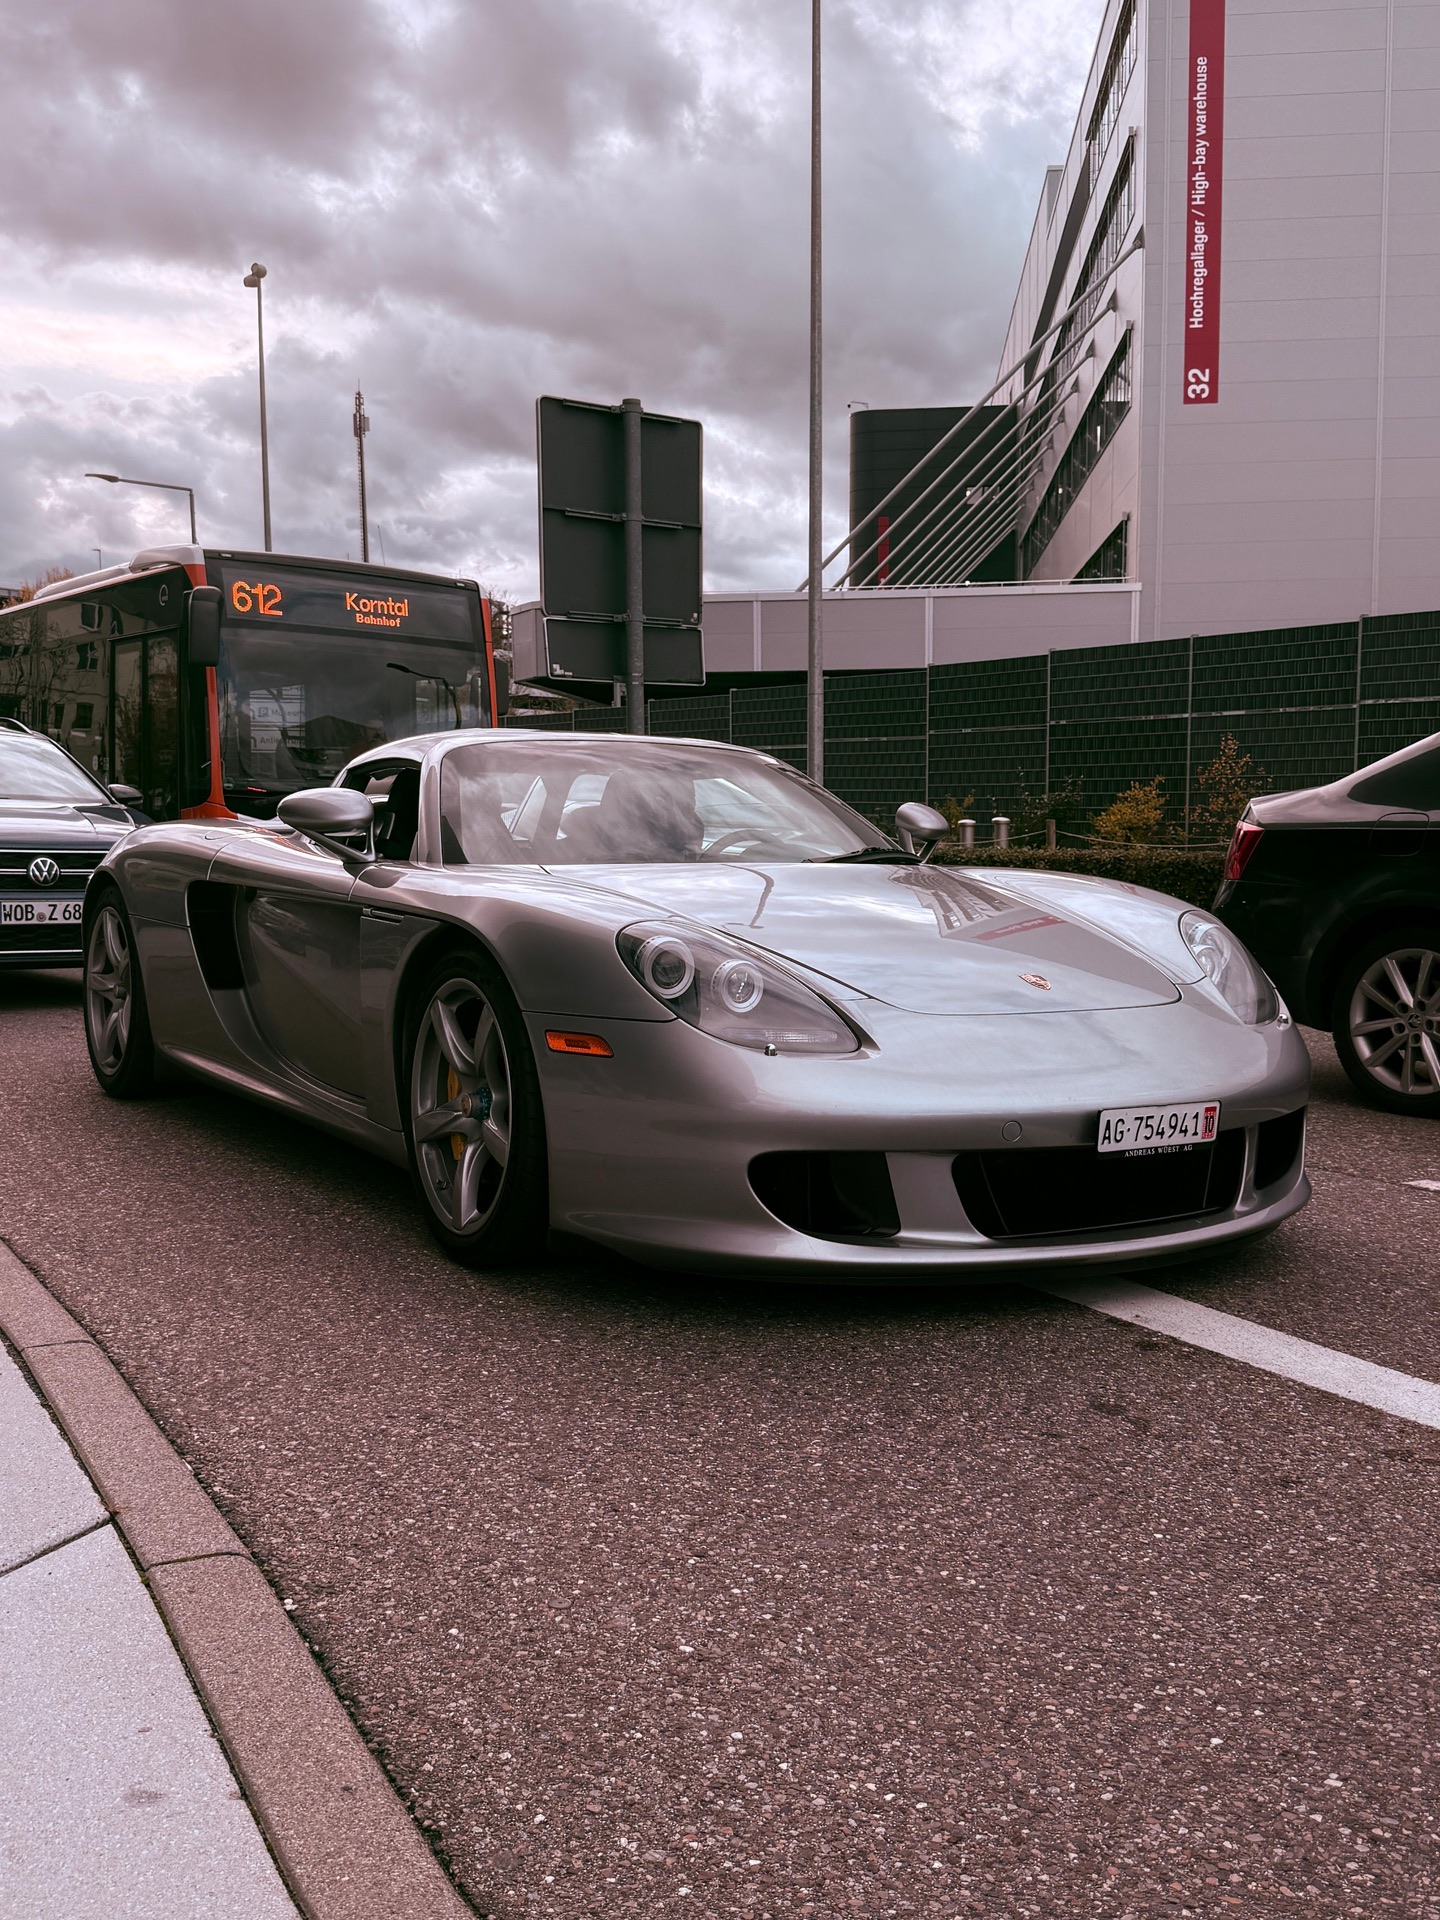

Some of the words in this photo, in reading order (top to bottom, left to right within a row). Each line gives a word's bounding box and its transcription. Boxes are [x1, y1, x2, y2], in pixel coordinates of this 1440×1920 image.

[1193, 56, 1208, 136] warehouse
[1191, 139, 1209, 205] High-bay
[1191, 209, 1205, 217] /
[1189, 220, 1208, 328] Hochregallager
[1188, 368, 1209, 399] 32
[232, 580, 283, 616] 612
[345, 592, 409, 617] Korntal
[355, 613, 401, 628] Bahnhof
[3, 904, 35, 921] WOB
[48, 904, 58, 920] Z
[1203, 1115, 1215, 1134] 10
[1124, 1148, 1155, 1157] ANDREAS
